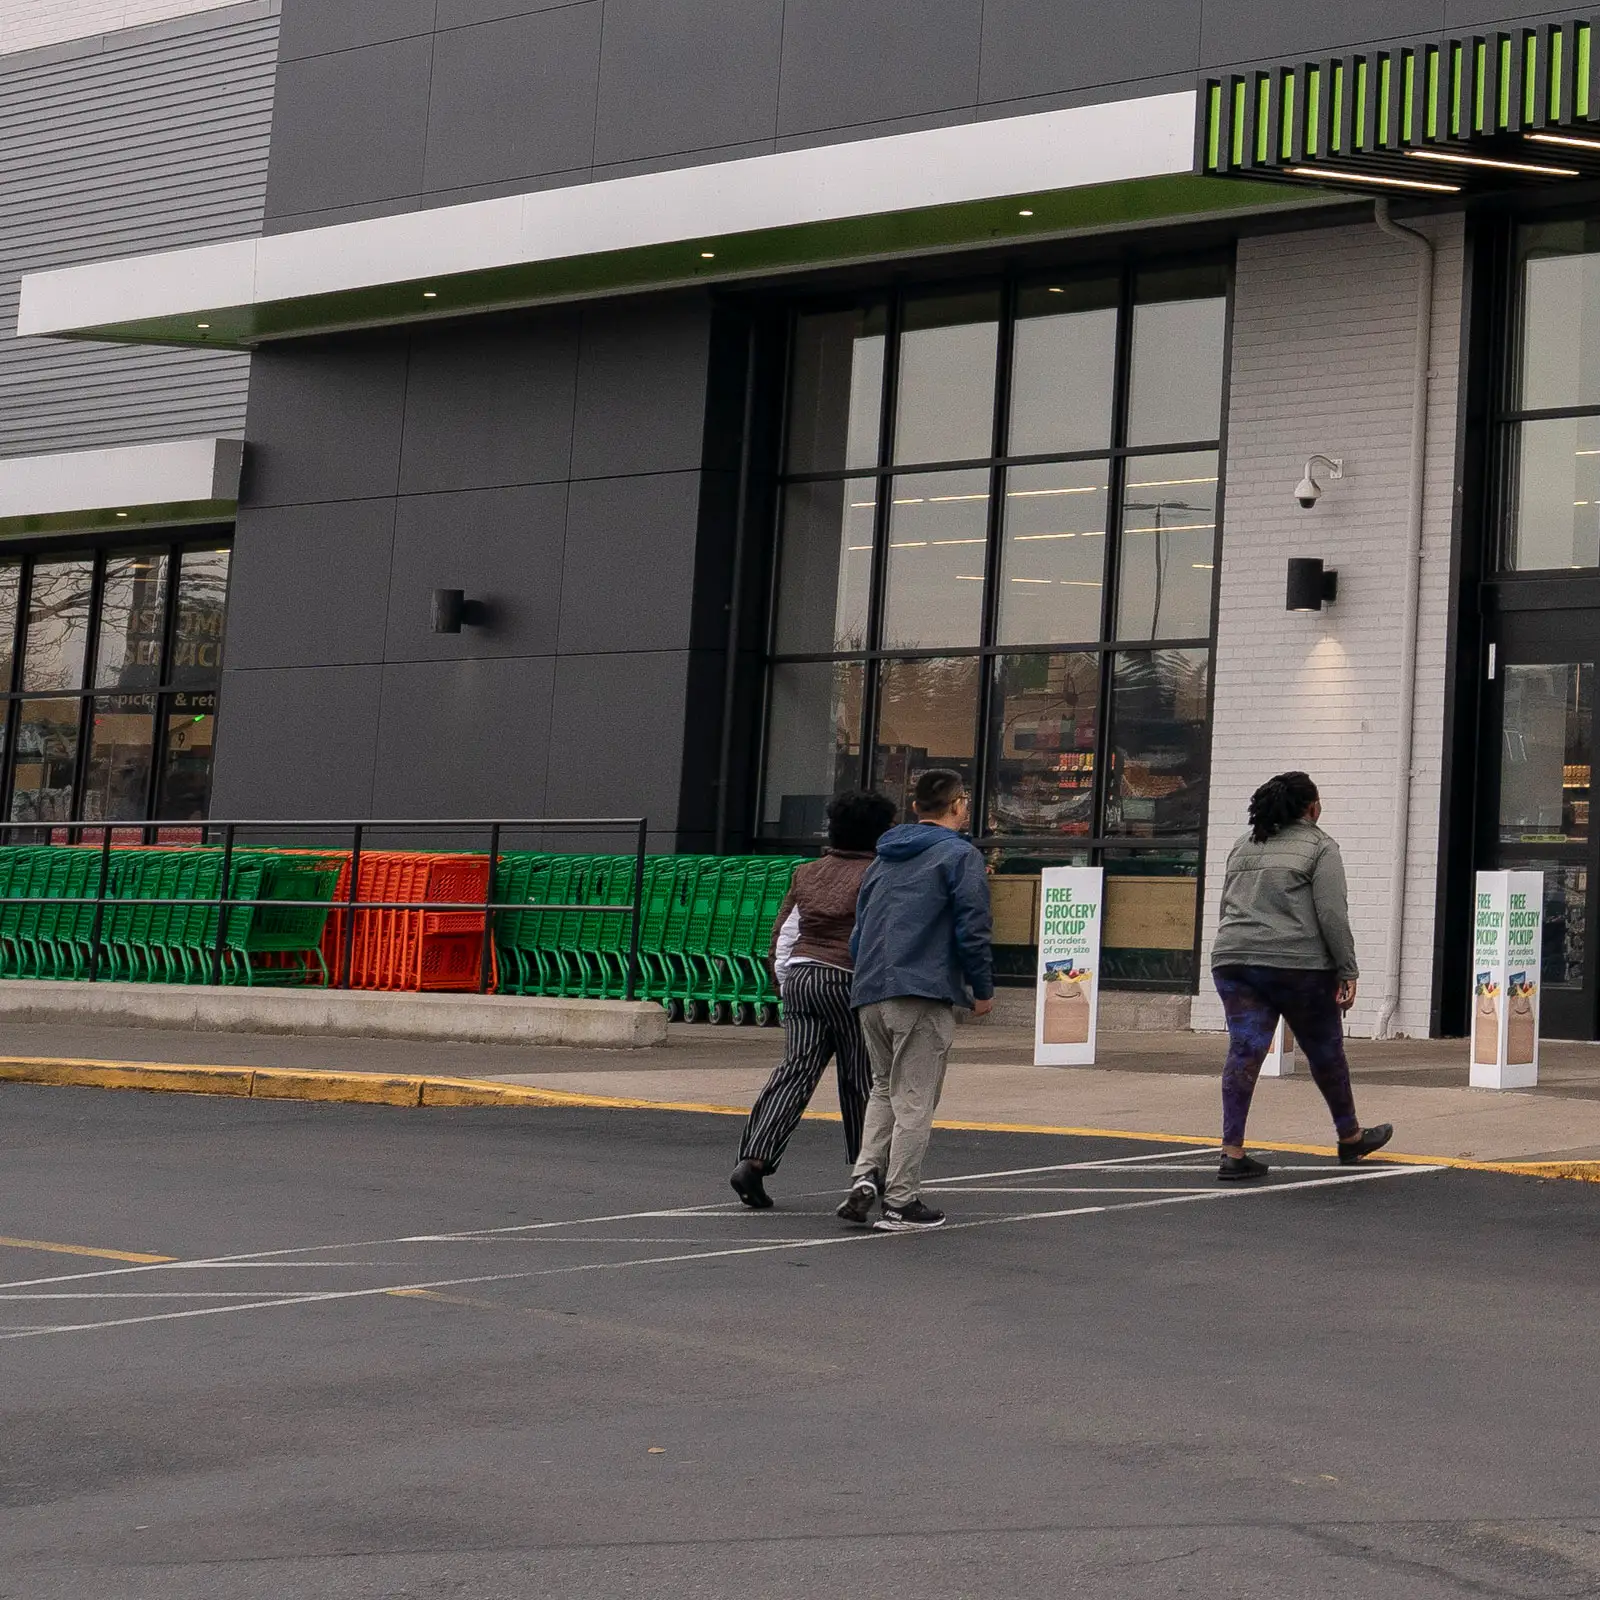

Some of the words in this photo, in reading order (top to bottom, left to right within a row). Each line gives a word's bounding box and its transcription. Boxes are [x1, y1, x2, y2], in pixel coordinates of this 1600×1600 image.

[1046, 888, 1072, 902] FREE
[1510, 894, 1526, 909] FREE
[1045, 904, 1096, 918] GROCERY
[1510, 912, 1540, 927] GROCERY
[1045, 921, 1085, 935] PICKUP
[1057, 936, 1087, 944] orders
[1509, 930, 1533, 945] PICKUP
[1043, 946, 1052, 954] of
